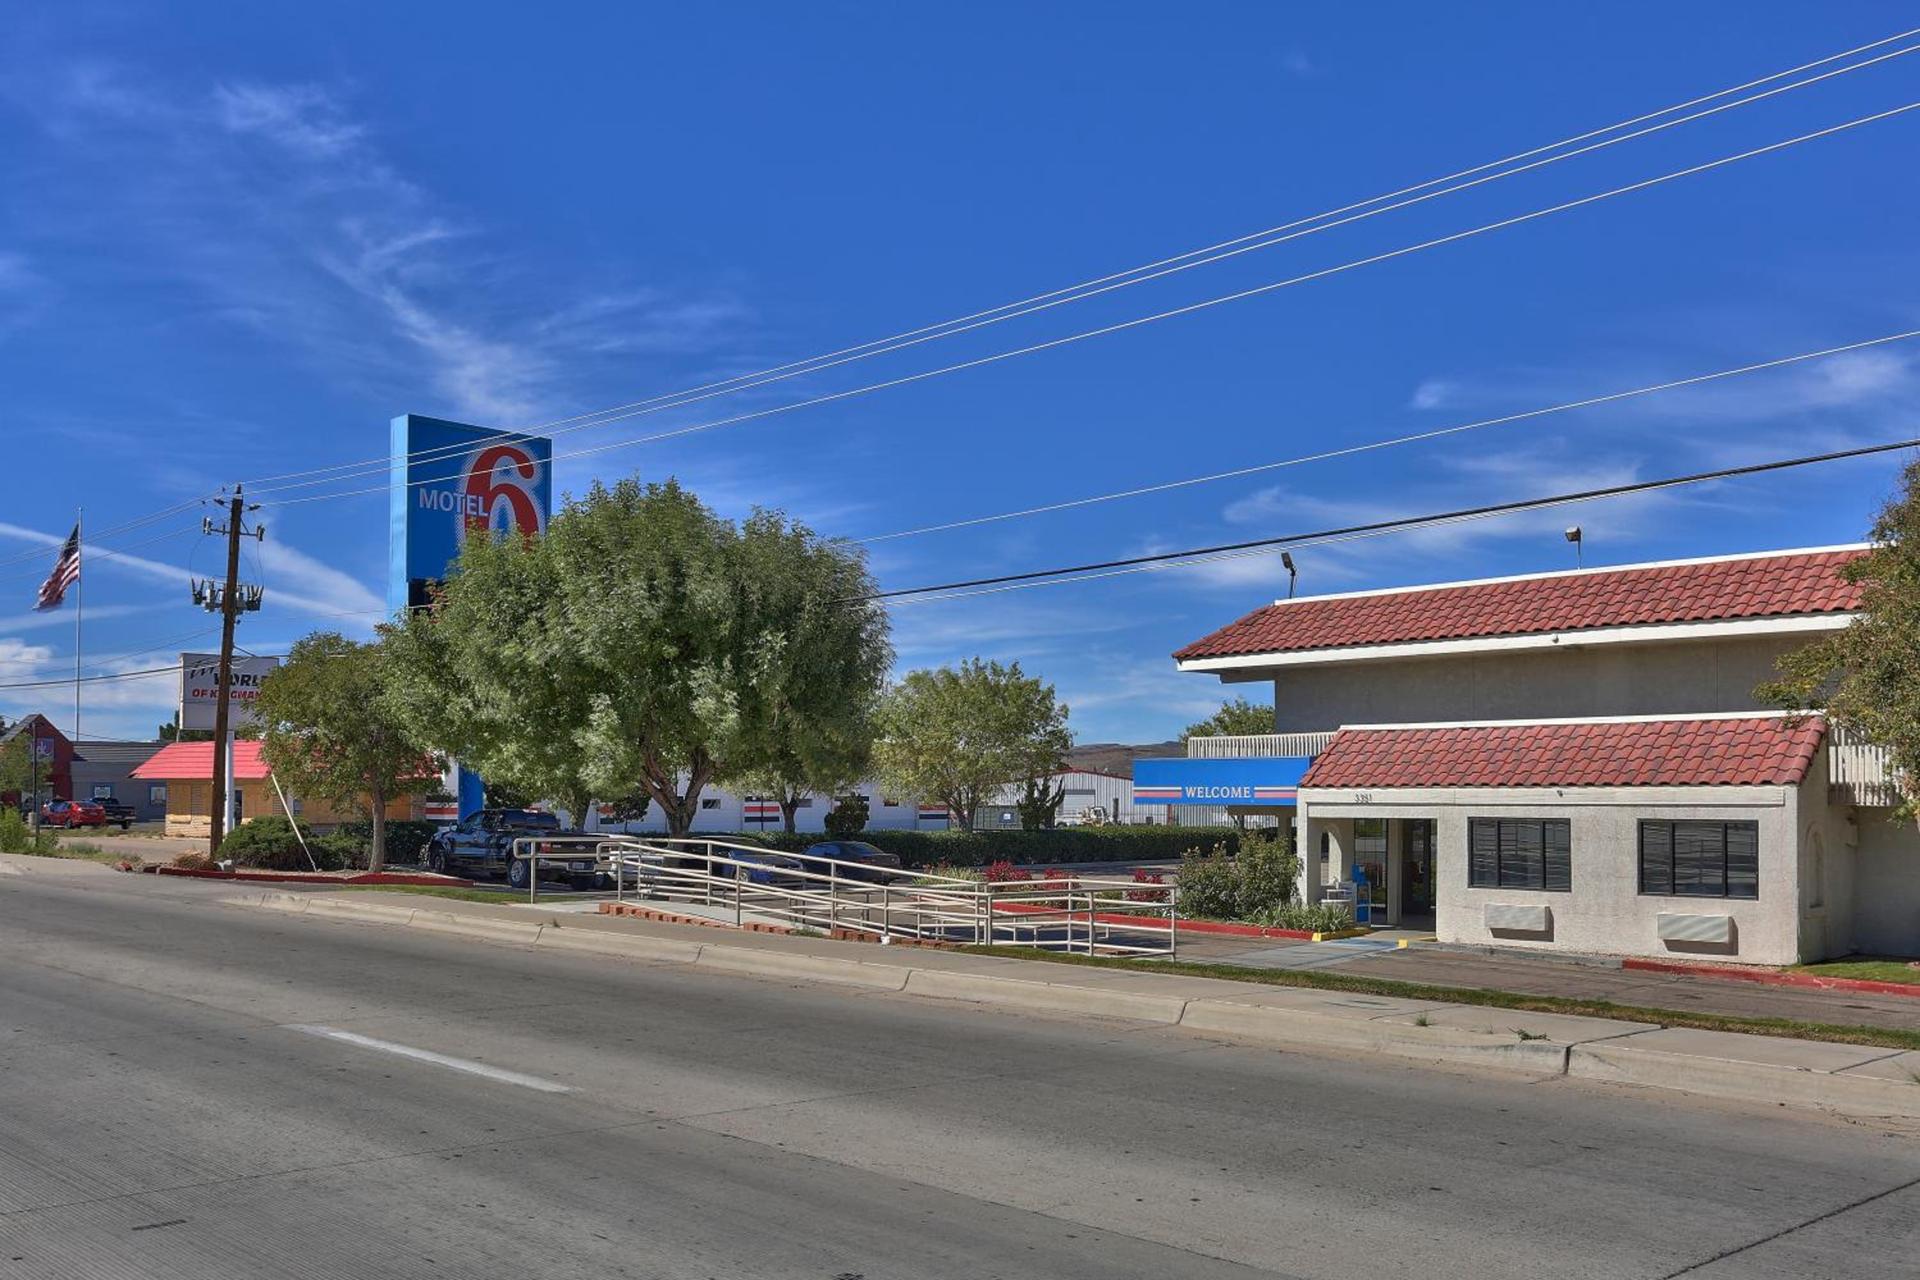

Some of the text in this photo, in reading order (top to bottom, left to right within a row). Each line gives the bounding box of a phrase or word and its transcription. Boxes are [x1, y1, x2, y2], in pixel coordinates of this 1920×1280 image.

[419, 444, 543, 548] MOTEL 6
[192, 688, 208, 698] OF
[1185, 786, 1252, 798] WELCOME
